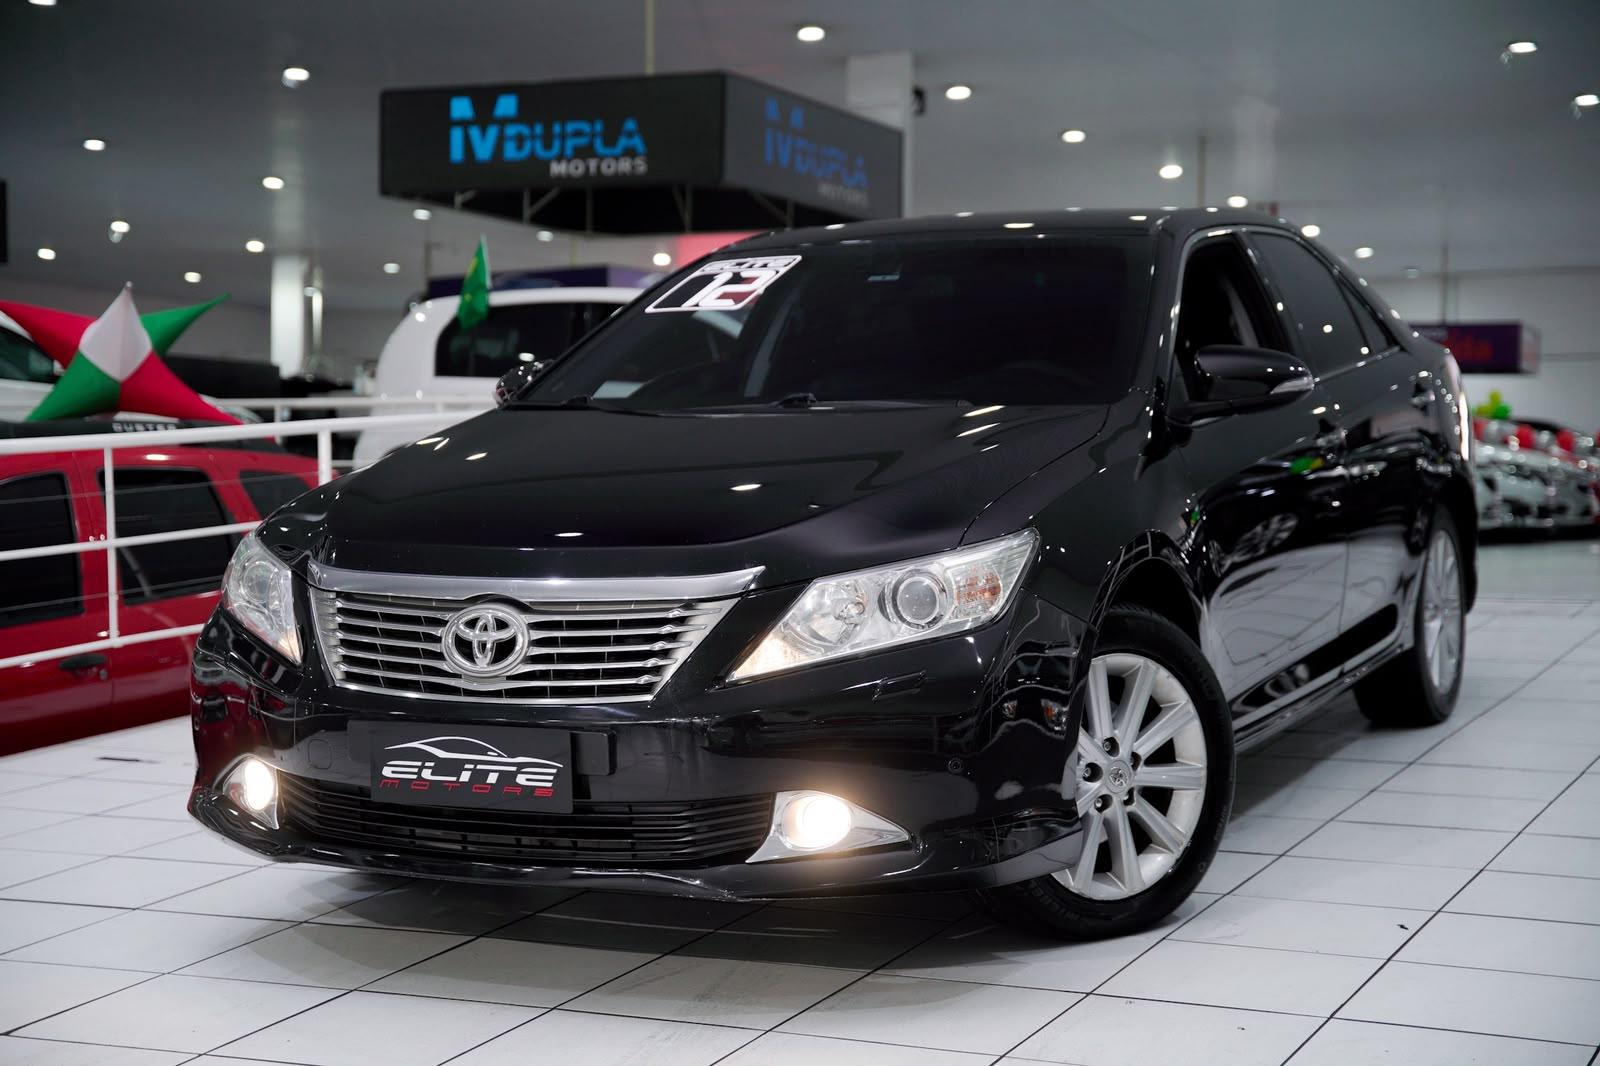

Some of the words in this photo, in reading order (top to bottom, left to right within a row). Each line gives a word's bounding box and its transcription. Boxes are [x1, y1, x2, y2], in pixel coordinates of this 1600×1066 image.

[549, 155, 648, 177] MOTORS
[681, 270, 778, 308] 12
[381, 760, 558, 787] ELITE
[379, 779, 554, 797] MOTORS
